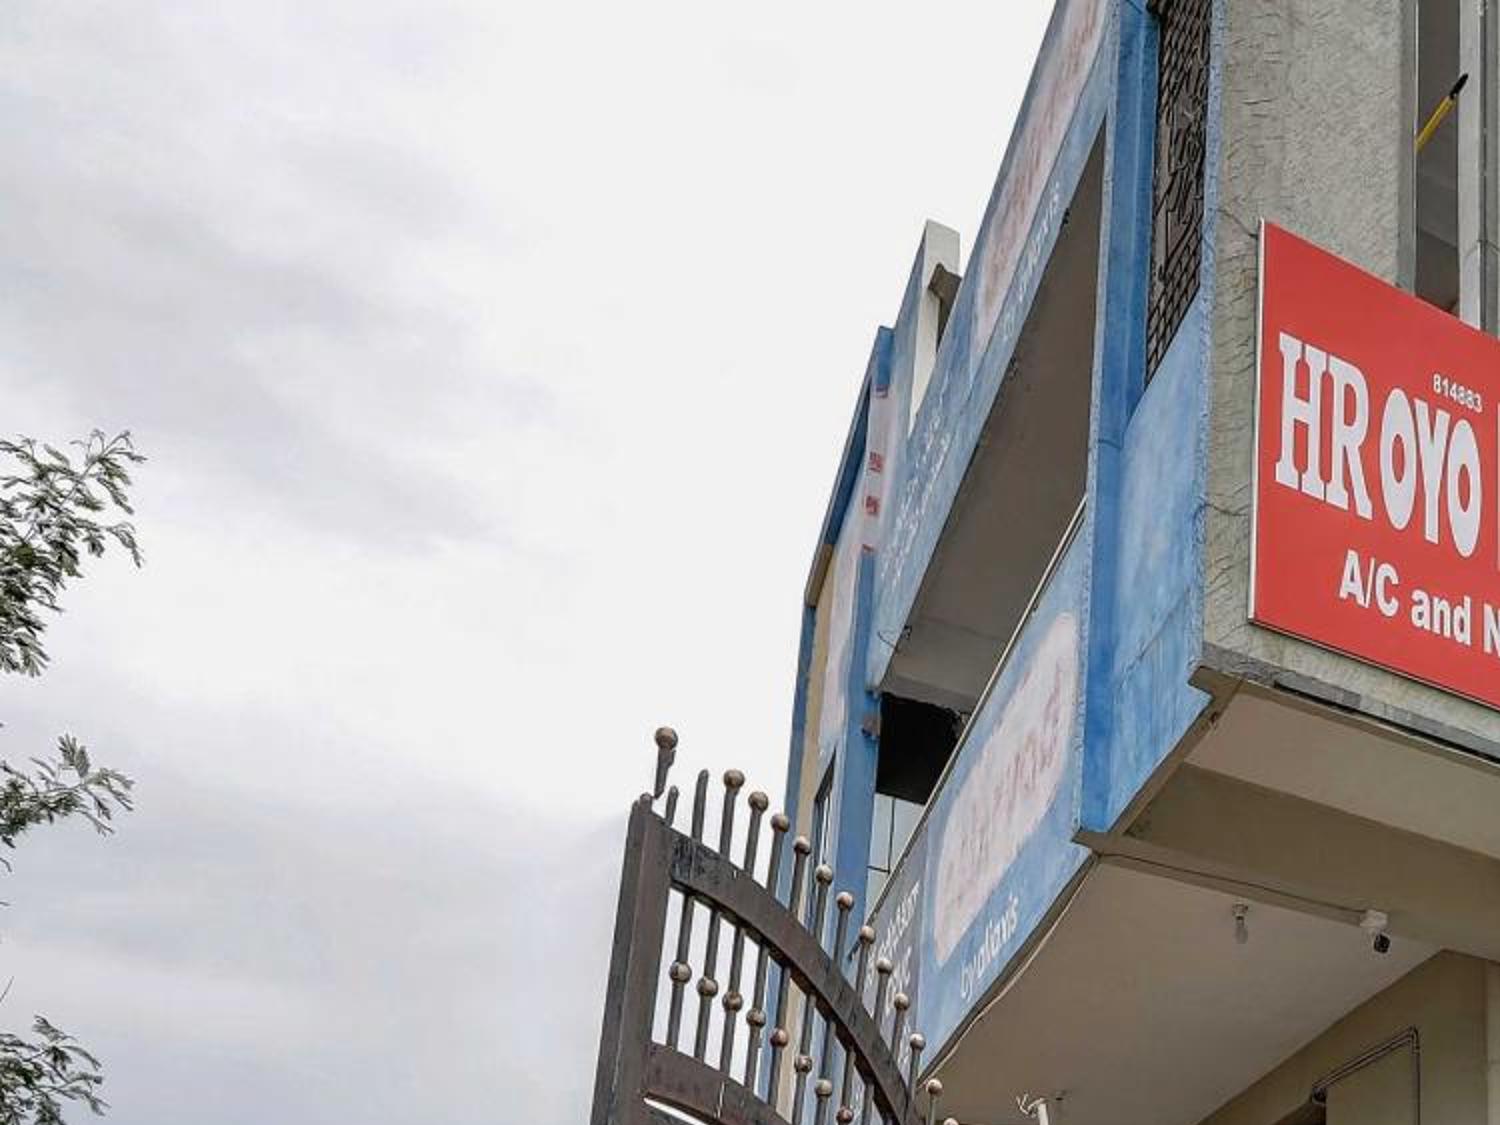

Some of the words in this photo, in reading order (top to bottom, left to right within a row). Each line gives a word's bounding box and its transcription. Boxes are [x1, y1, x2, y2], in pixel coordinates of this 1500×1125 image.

[1275, 331, 1373, 520] HR
[1380, 387, 1482, 557] OYO
[1339, 549, 1399, 617] A/C
[1411, 589, 1472, 646] and
